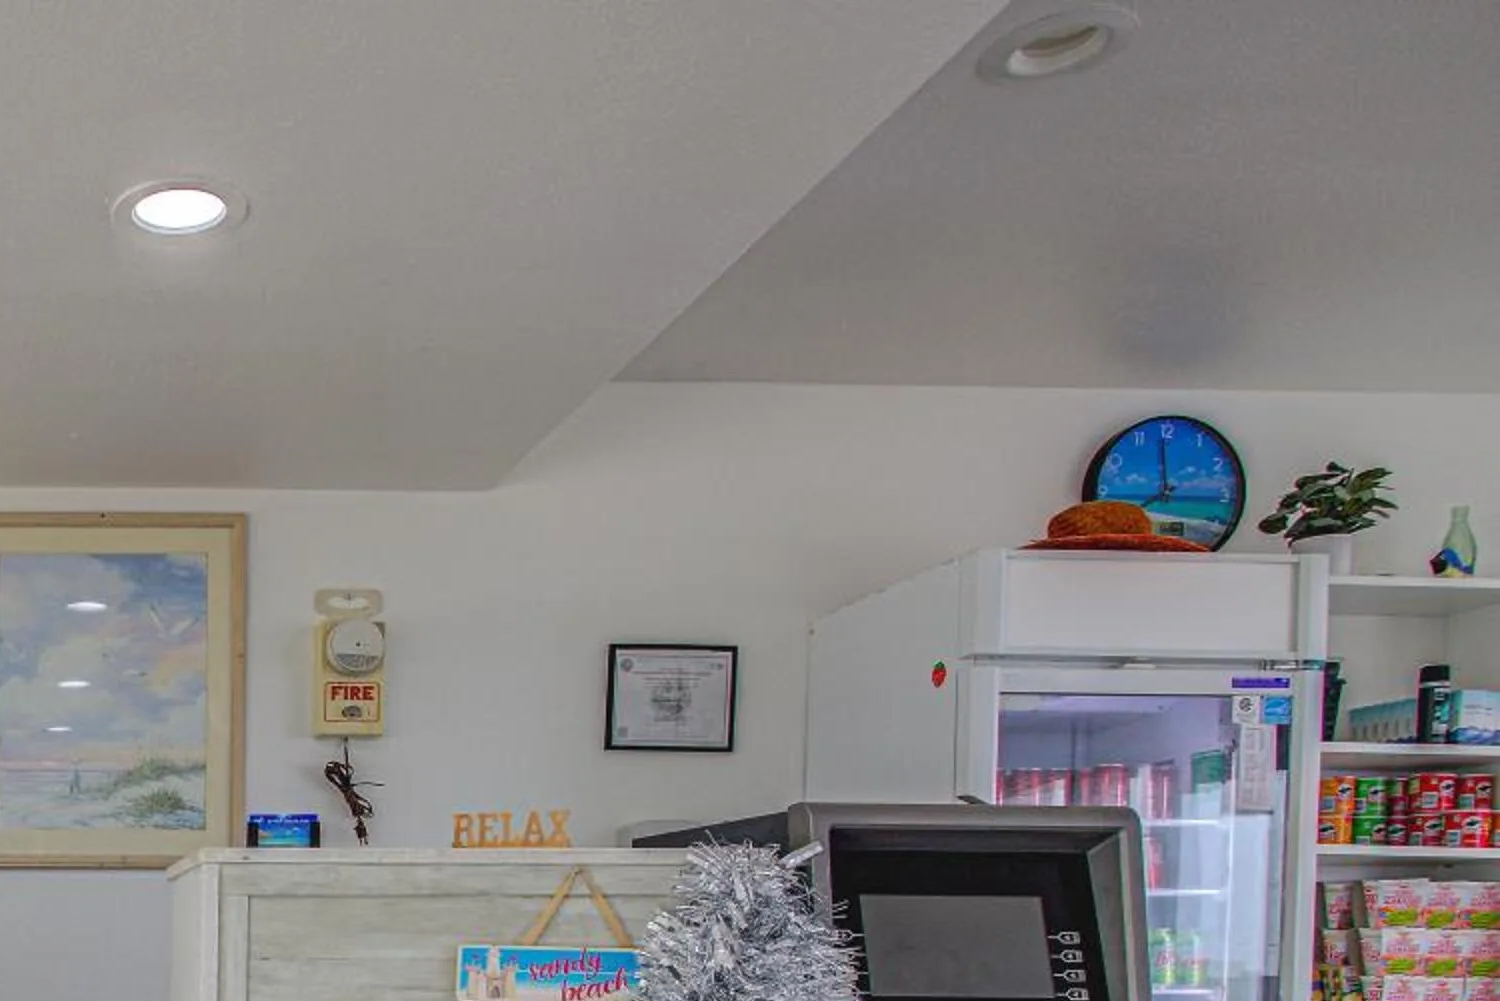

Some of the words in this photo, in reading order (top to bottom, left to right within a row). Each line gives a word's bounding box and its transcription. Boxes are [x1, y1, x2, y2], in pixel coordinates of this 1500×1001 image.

[1134, 431, 1146, 447] 11
[1160, 423, 1175, 439] 12
[1196, 433, 1204, 448] 1
[1213, 457, 1224, 472] 2
[1220, 487, 1231, 503] 3
[330, 685, 375, 701] FIRE
[452, 810, 571, 849] RELAX
[529, 945, 601, 981] sandy
[561, 966, 628, 1001] beach
